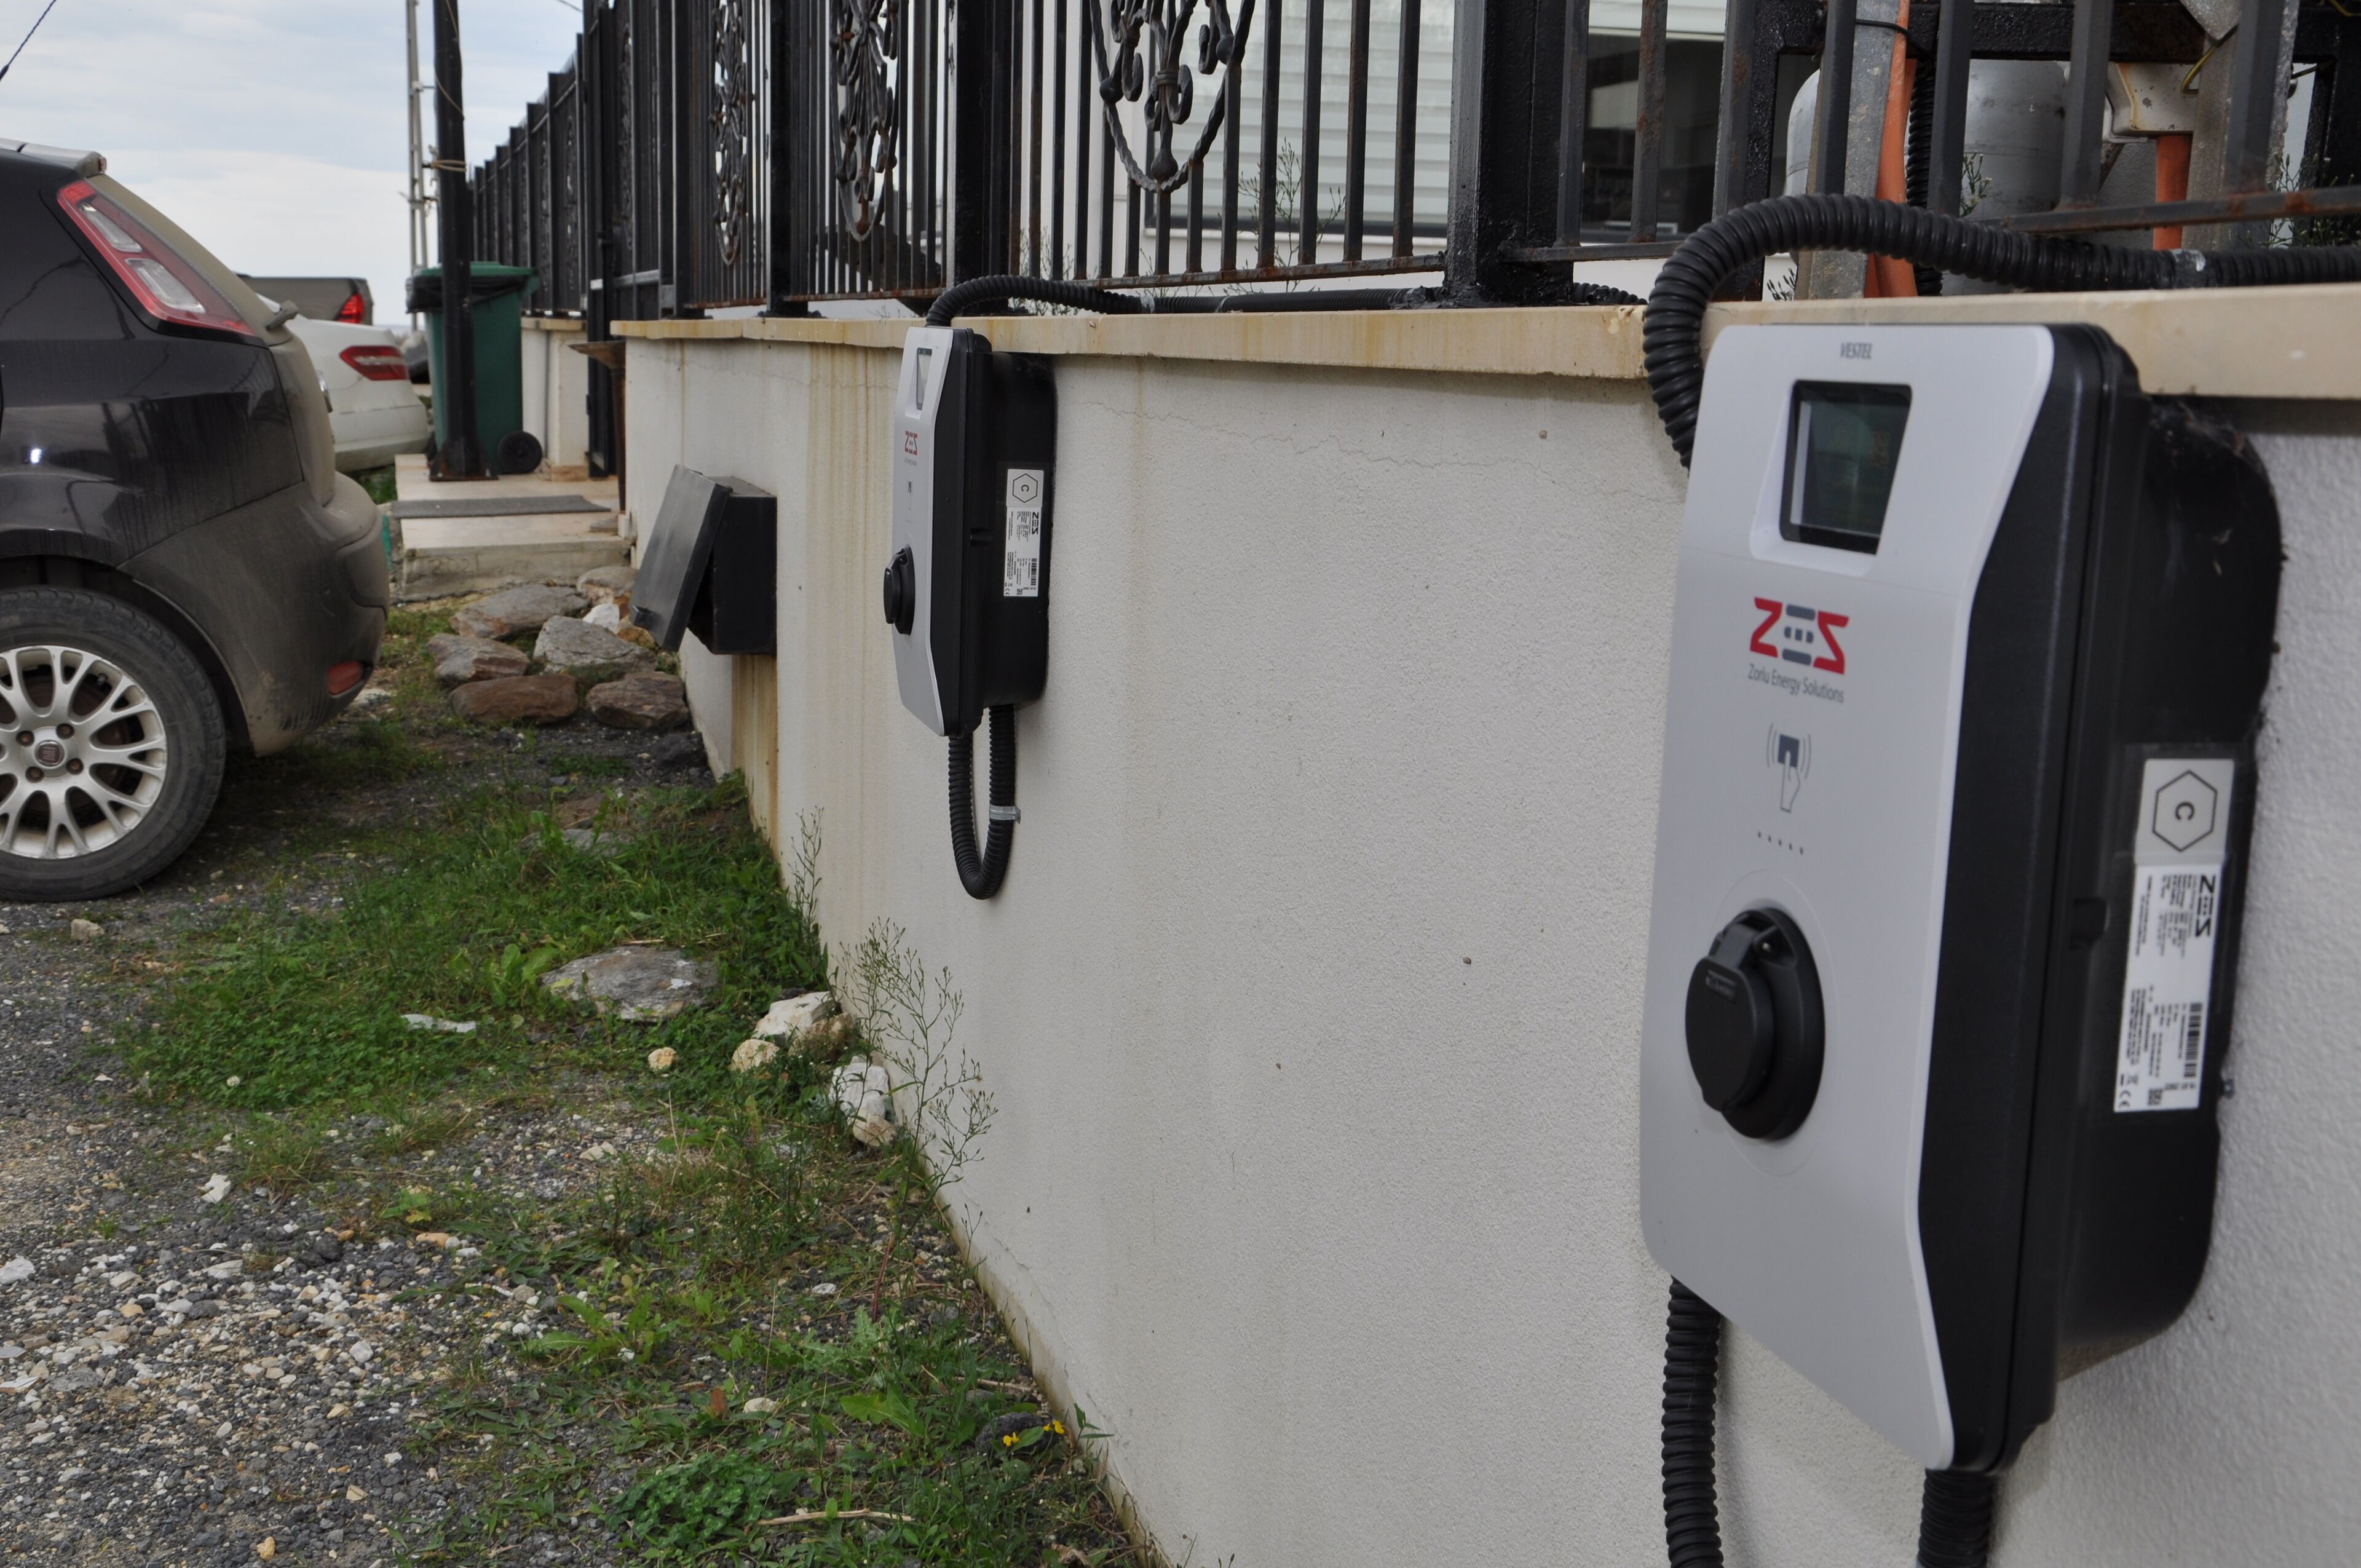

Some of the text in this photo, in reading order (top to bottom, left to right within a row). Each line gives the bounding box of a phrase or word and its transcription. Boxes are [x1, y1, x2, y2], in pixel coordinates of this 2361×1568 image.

[1840, 342, 1873, 359] VESTEL
[904, 430, 918, 456] ZES
[1749, 596, 1849, 675] ZES
[1748, 663, 1845, 704] Zorlu Energy Solutions
[2175, 801, 2195, 821] C
